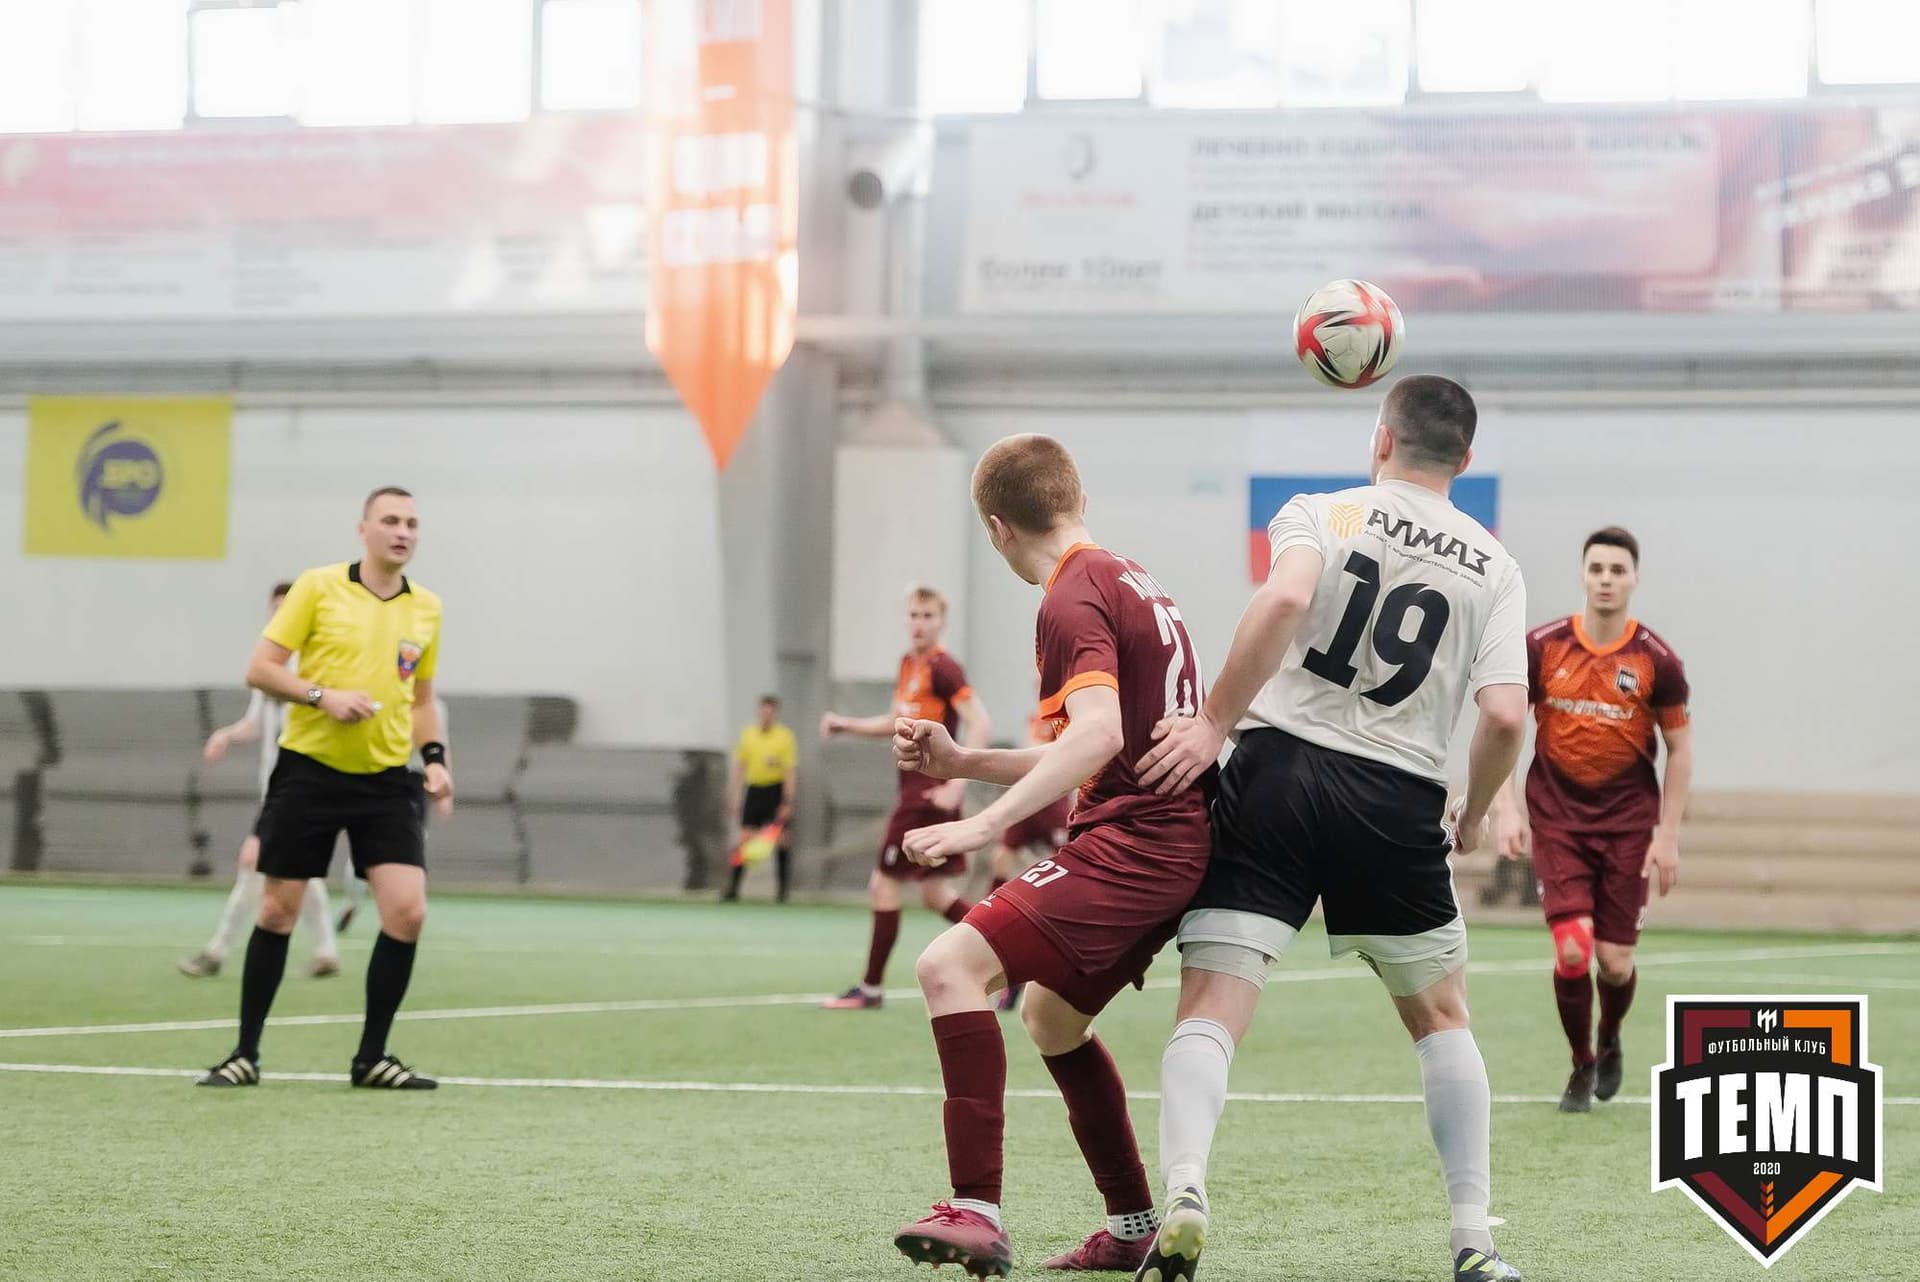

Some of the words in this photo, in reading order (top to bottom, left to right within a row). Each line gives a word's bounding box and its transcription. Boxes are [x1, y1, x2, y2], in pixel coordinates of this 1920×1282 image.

[1367, 508, 1492, 577] АЛМАЗ
[1301, 550, 1450, 707] 19
[1020, 859, 1069, 888] 27
